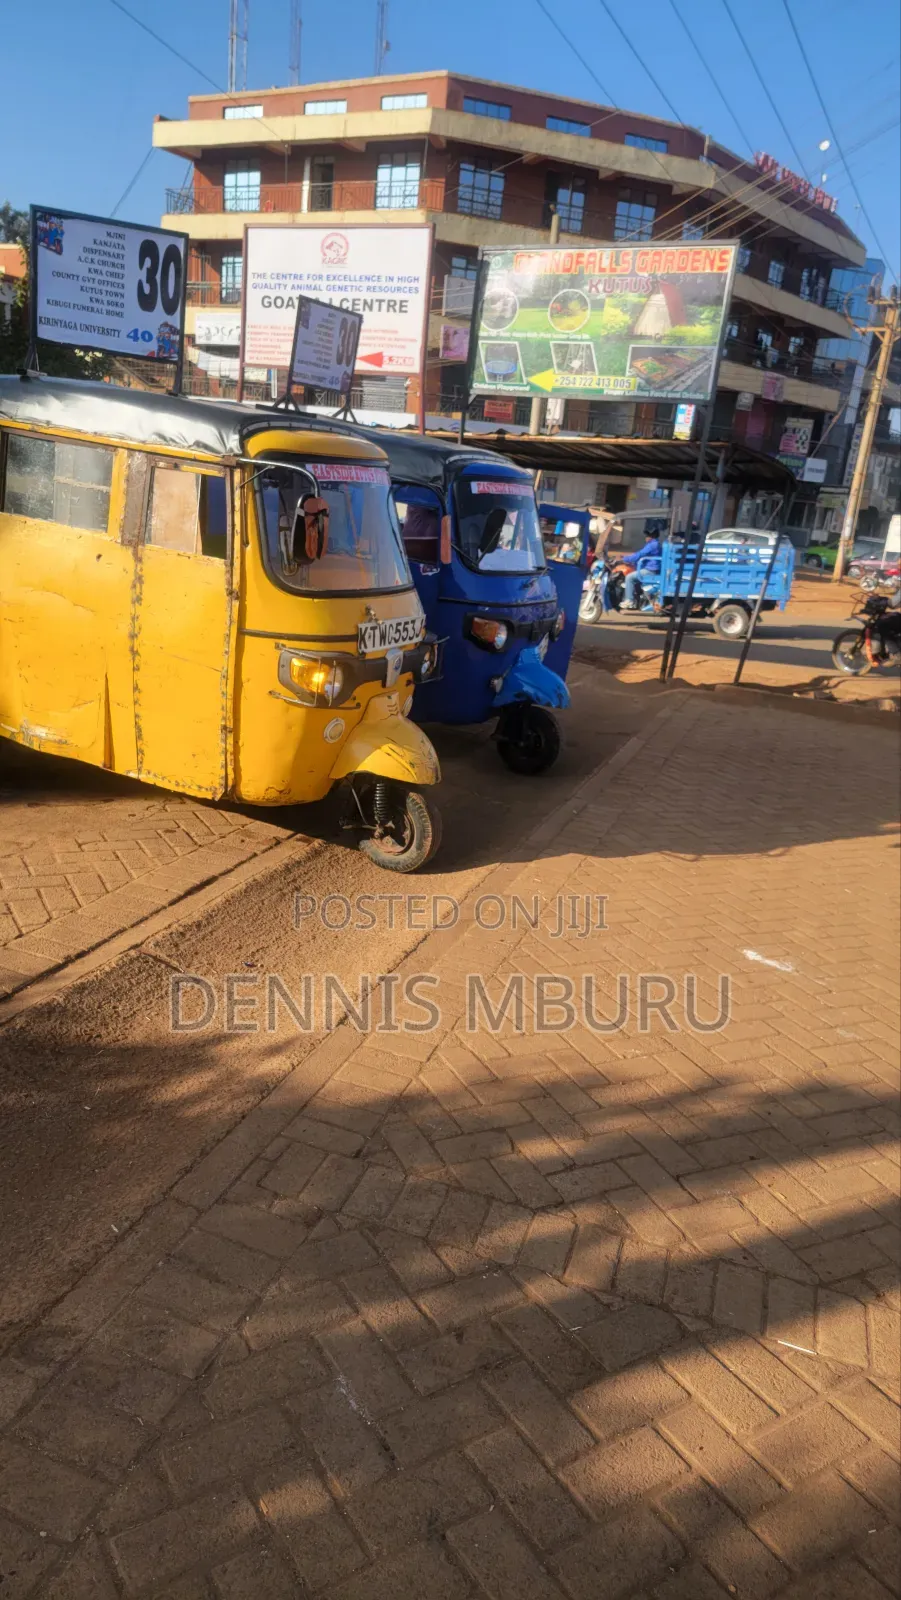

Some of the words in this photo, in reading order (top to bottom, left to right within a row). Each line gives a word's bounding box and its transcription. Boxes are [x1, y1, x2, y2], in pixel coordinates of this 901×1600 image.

[106, 231, 126, 241] MJINI
[93, 238, 126, 251] KANJATA
[82, 246, 126, 261] DISPENSARY
[635, 247, 731, 274] GARDENS
[77, 255, 96, 265] A.C.K
[97, 259, 126, 271] CHURCH
[51, 270, 80, 282] COUNTY
[81, 275, 96, 285] GVT
[97, 279, 125, 290] OFFICES
[88, 267, 104, 277] KWA
[105, 270, 125, 281] CHIEF
[137, 238, 182, 317] 30
[252, 272, 268, 280] THE
[270, 273, 304, 281] CENTRE
[306, 273, 324, 282] FOR
[326, 274, 383, 283] EXCELLENCE
[385, 275, 395, 283] IN
[397, 276, 420, 284] HIGH
[80, 285, 103, 296] KUTUS
[104, 289, 125, 300] TOWN
[252, 282, 288, 291] QUALITY
[291, 284, 324, 292] ANIMAL
[325, 284, 364, 293] GENETIC
[366, 285, 420, 294] RESOURCES
[588, 276, 653, 294] KUTUS
[46, 298, 71, 309] KIBUGI
[72, 303, 105, 315] FUNERAL
[105, 309, 125, 319] HOME
[89, 296, 105, 306] KWA
[106, 299, 125, 309] SOKO
[340, 297, 410, 314] CENTRE
[38, 315, 78, 332] KIRINYAGA
[80, 323, 122, 339] UNIVERSITY
[126, 328, 154, 343] 40
[554, 376, 576, 386] +254
[578, 377, 593, 387] 722
[596, 377, 611, 388] 413
